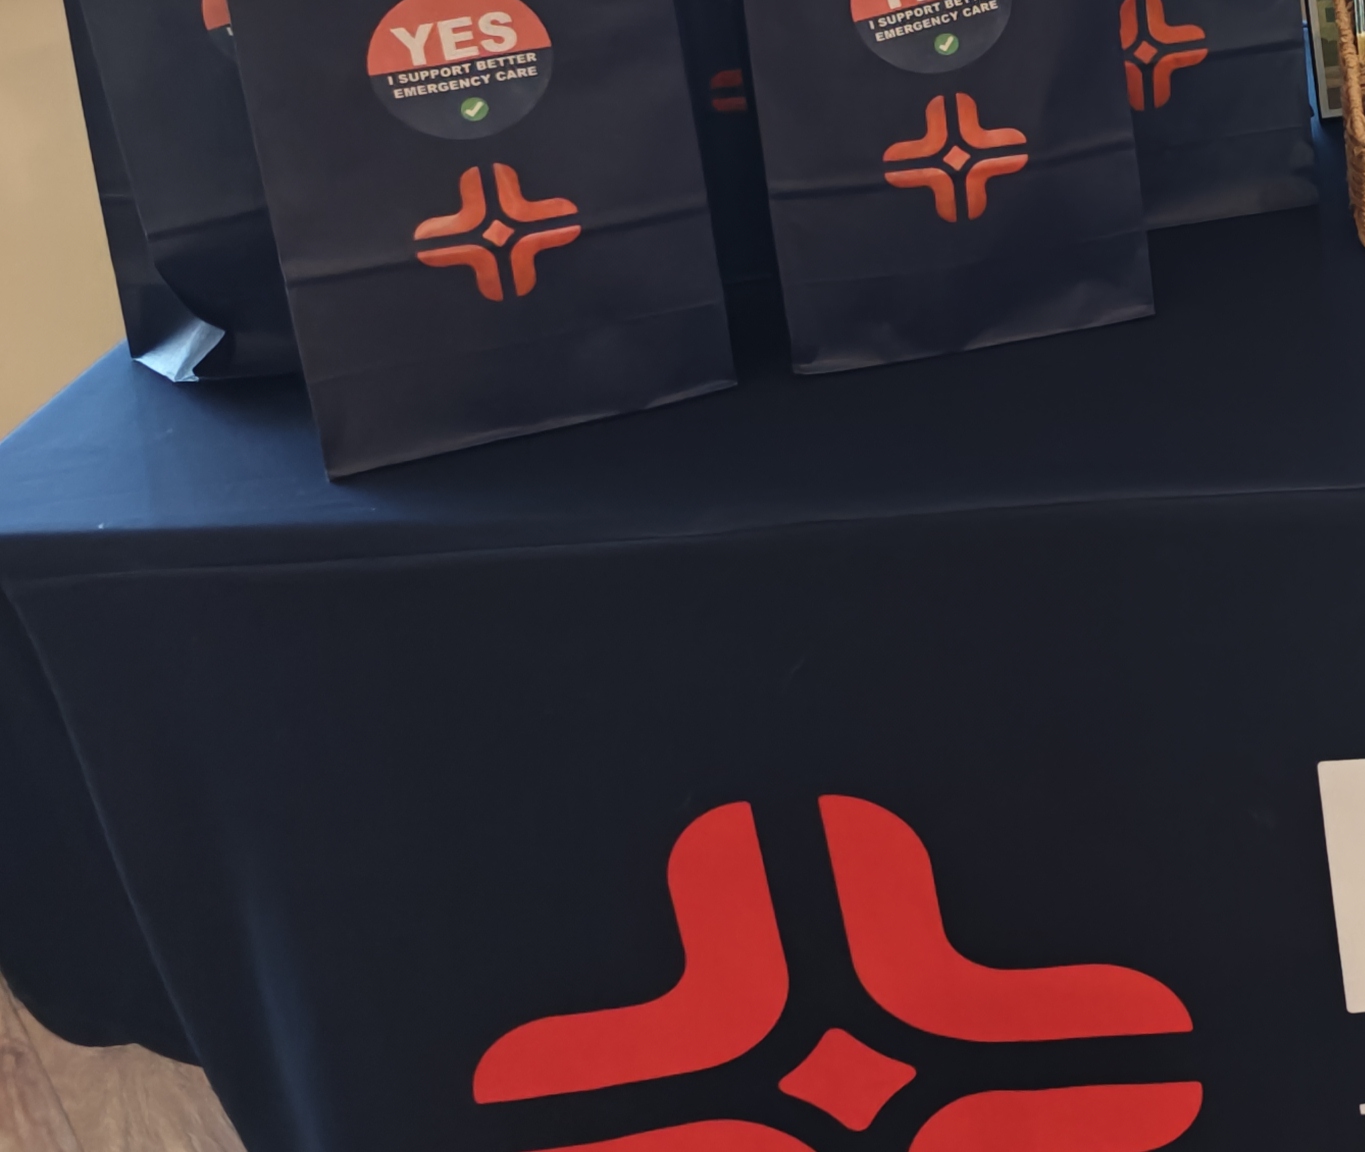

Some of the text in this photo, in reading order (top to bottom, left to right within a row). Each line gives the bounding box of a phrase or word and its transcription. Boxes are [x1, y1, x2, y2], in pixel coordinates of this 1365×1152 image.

[869, 21, 875, 29] I
[878, 2, 940, 27] SUPPORT
[875, 0, 998, 42] EMERGENCY CARE
[390, 11, 517, 66] YES
[387, 52, 537, 86] I SUPPORT BETTER
[393, 66, 538, 99] EMERGENCY CARE
